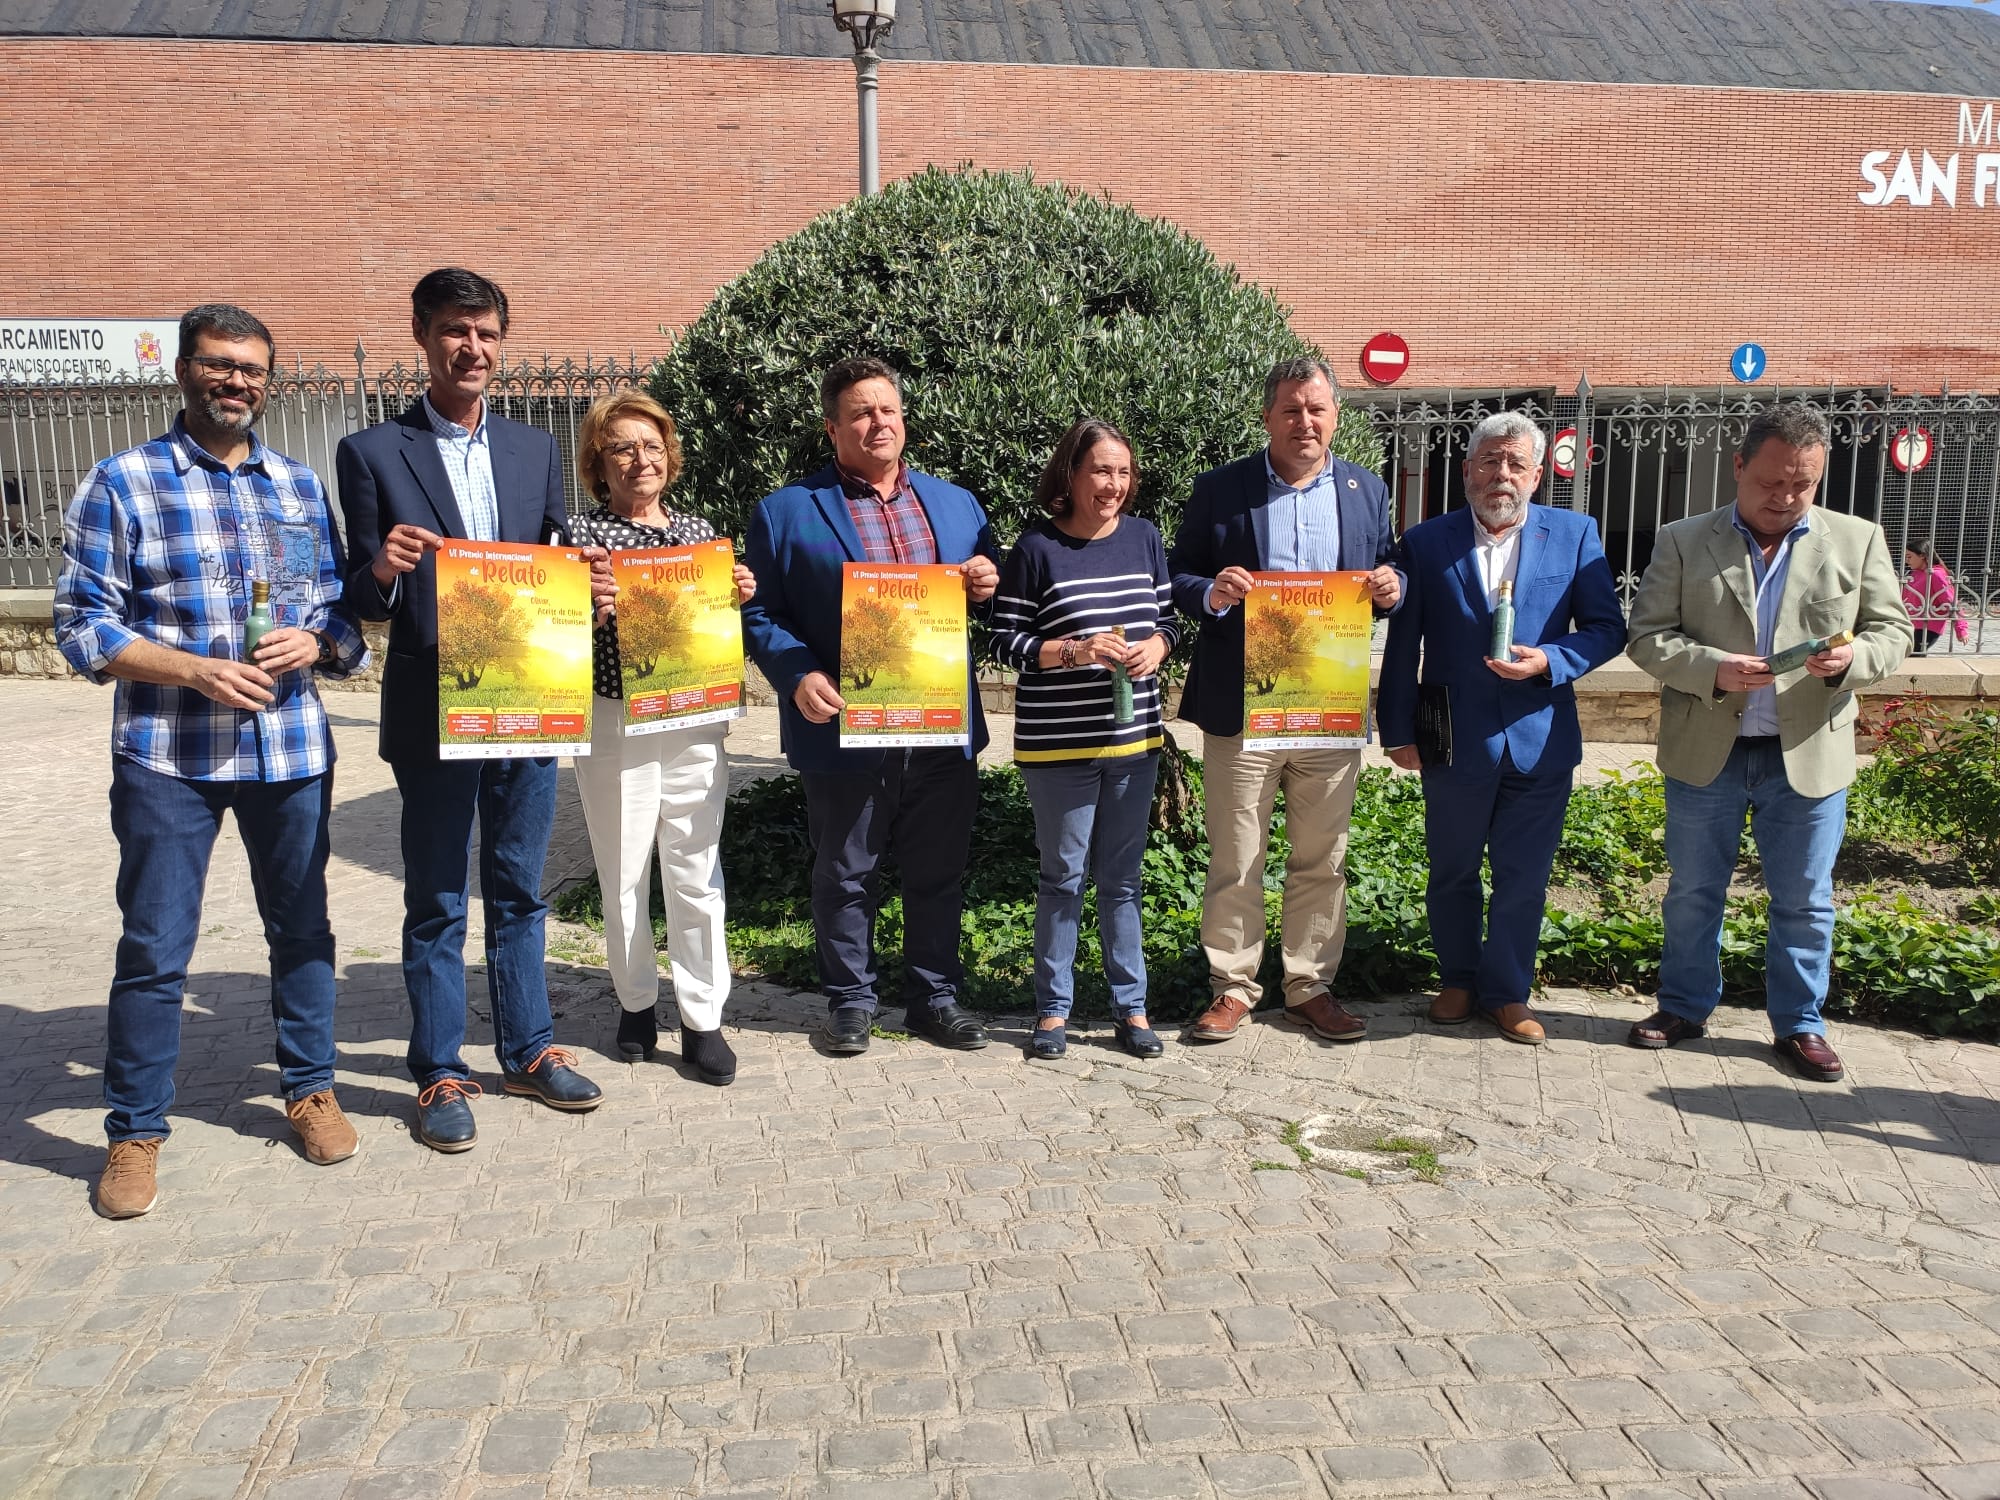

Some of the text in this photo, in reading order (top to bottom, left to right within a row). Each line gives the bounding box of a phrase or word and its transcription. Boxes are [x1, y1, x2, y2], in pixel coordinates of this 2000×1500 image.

[1957, 101, 2000, 145] M
[1857, 147, 2000, 208] SAN F
[0, 328, 104, 351] RCAMIENTO
[448, 548, 534, 563] VI Premio Internacional
[622, 552, 694, 567] VI Premio Internacional
[469, 560, 547, 588] de Relato
[651, 562, 704, 585] Relato
[860, 571, 879, 580] Premio
[880, 571, 918, 580] Internacional
[1284, 578, 1323, 588] Internacional
[877, 579, 929, 601] Relato
[1280, 587, 1334, 608] Relato
